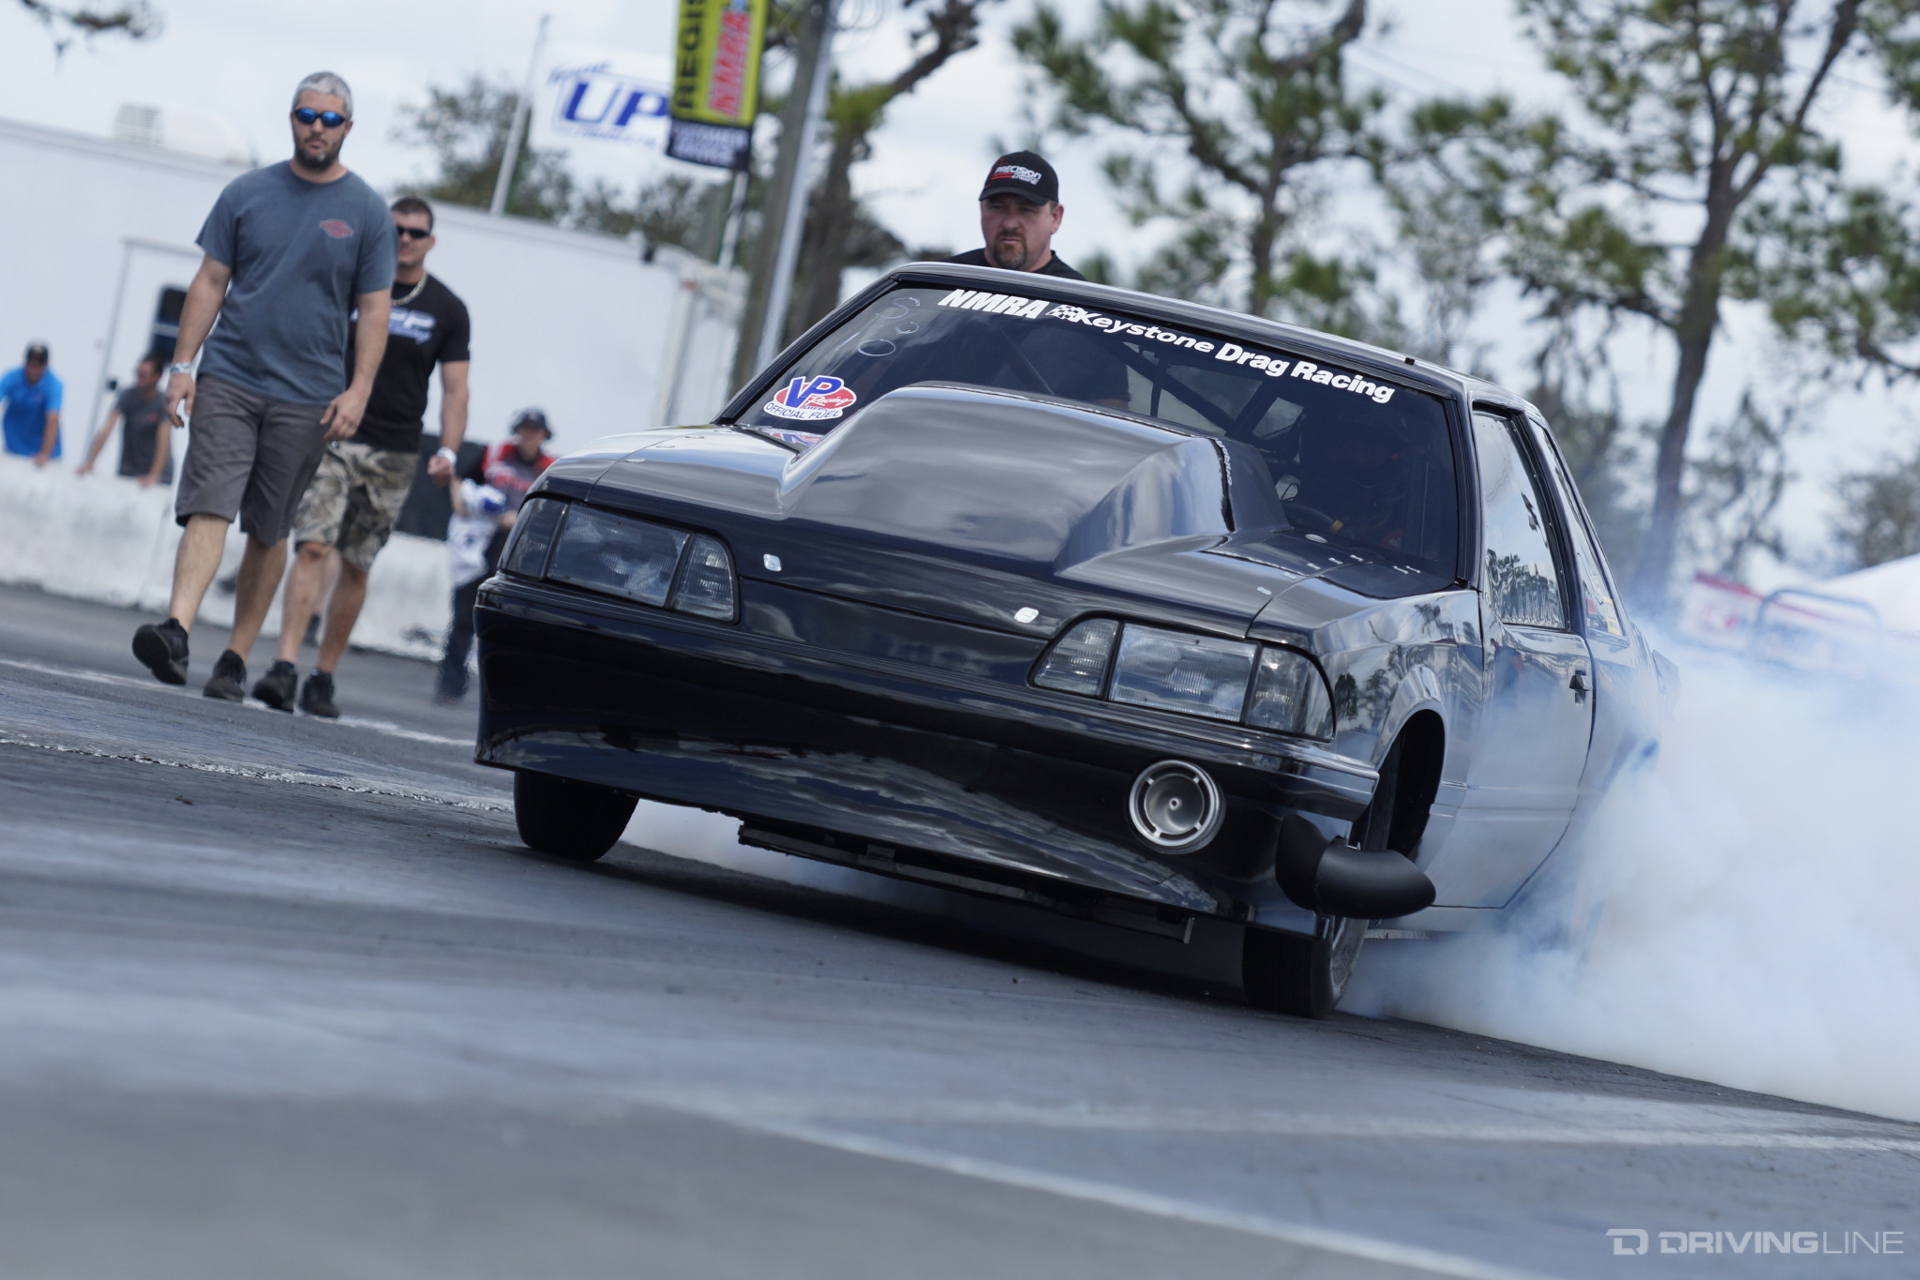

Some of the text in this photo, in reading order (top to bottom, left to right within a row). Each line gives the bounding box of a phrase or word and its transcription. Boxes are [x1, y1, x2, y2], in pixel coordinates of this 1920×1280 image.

[937, 288, 1395, 404] NMRA Keystone Drag Racing
[784, 375, 844, 409] VP
[765, 402, 840, 419] OFFICIAL FUEL
